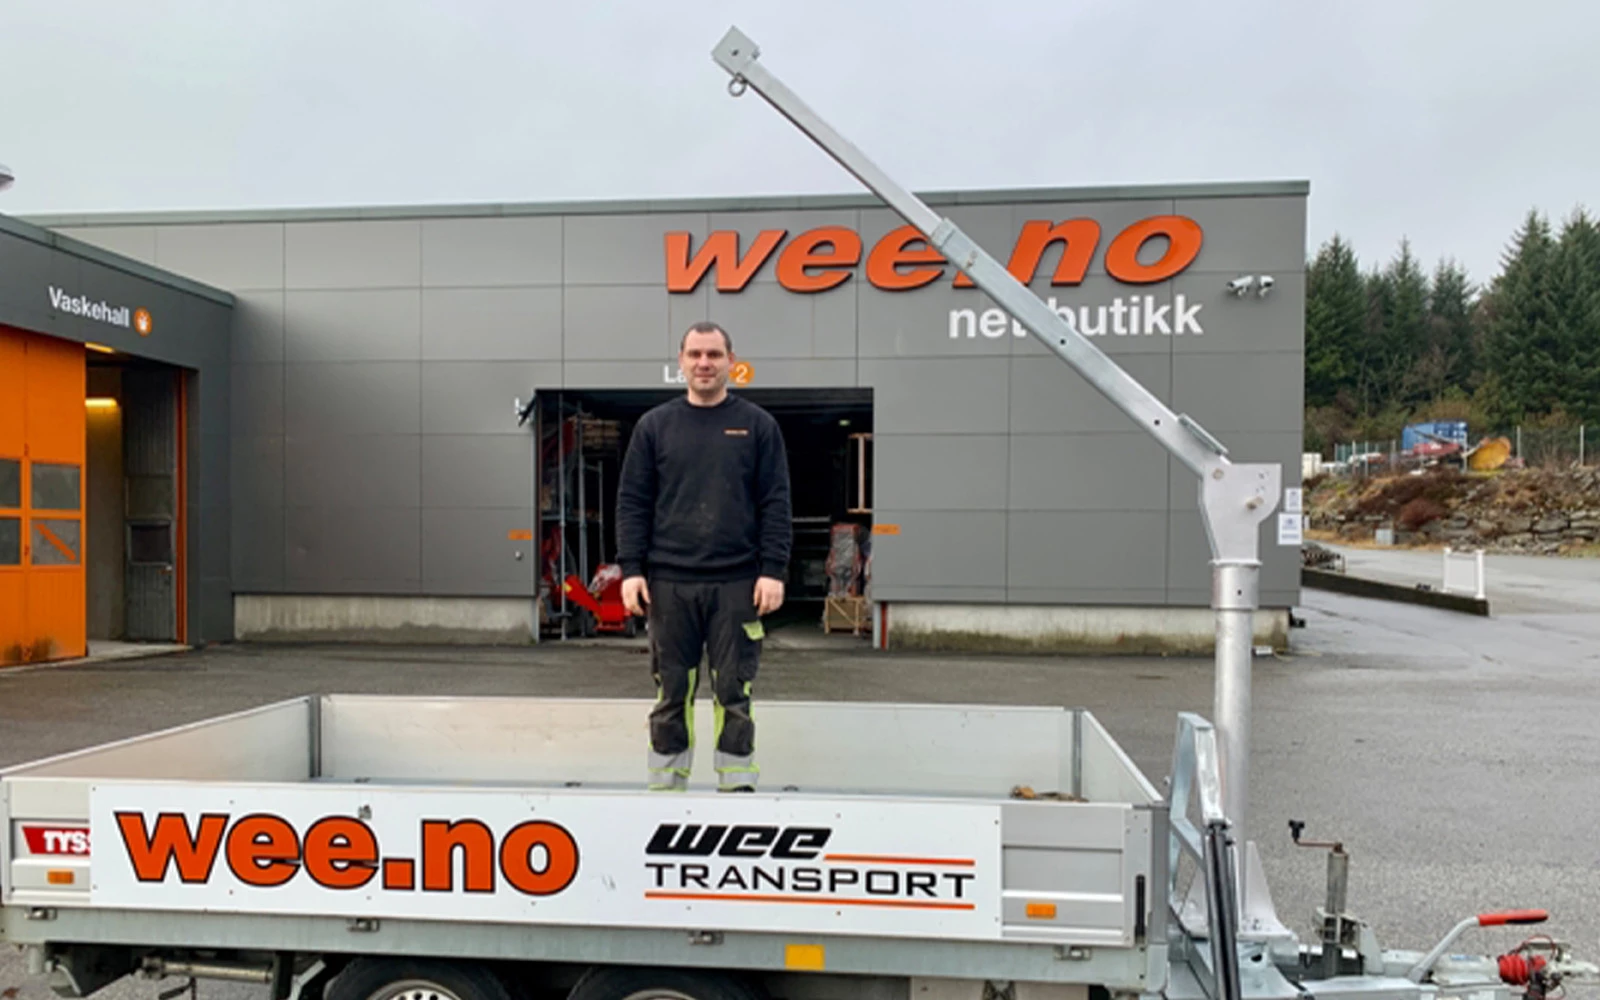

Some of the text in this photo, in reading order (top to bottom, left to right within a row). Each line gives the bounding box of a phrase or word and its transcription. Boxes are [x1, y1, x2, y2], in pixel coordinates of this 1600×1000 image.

[49, 286, 130, 328] Vaskehall
[949, 295, 1204, 339] nebutikk
[735, 363, 749, 384] 2
[43, 830, 91, 854] TYS
[114, 811, 580, 896] wee.no
[645, 823, 833, 859] wee
[645, 863, 976, 898] TRANSPORT
